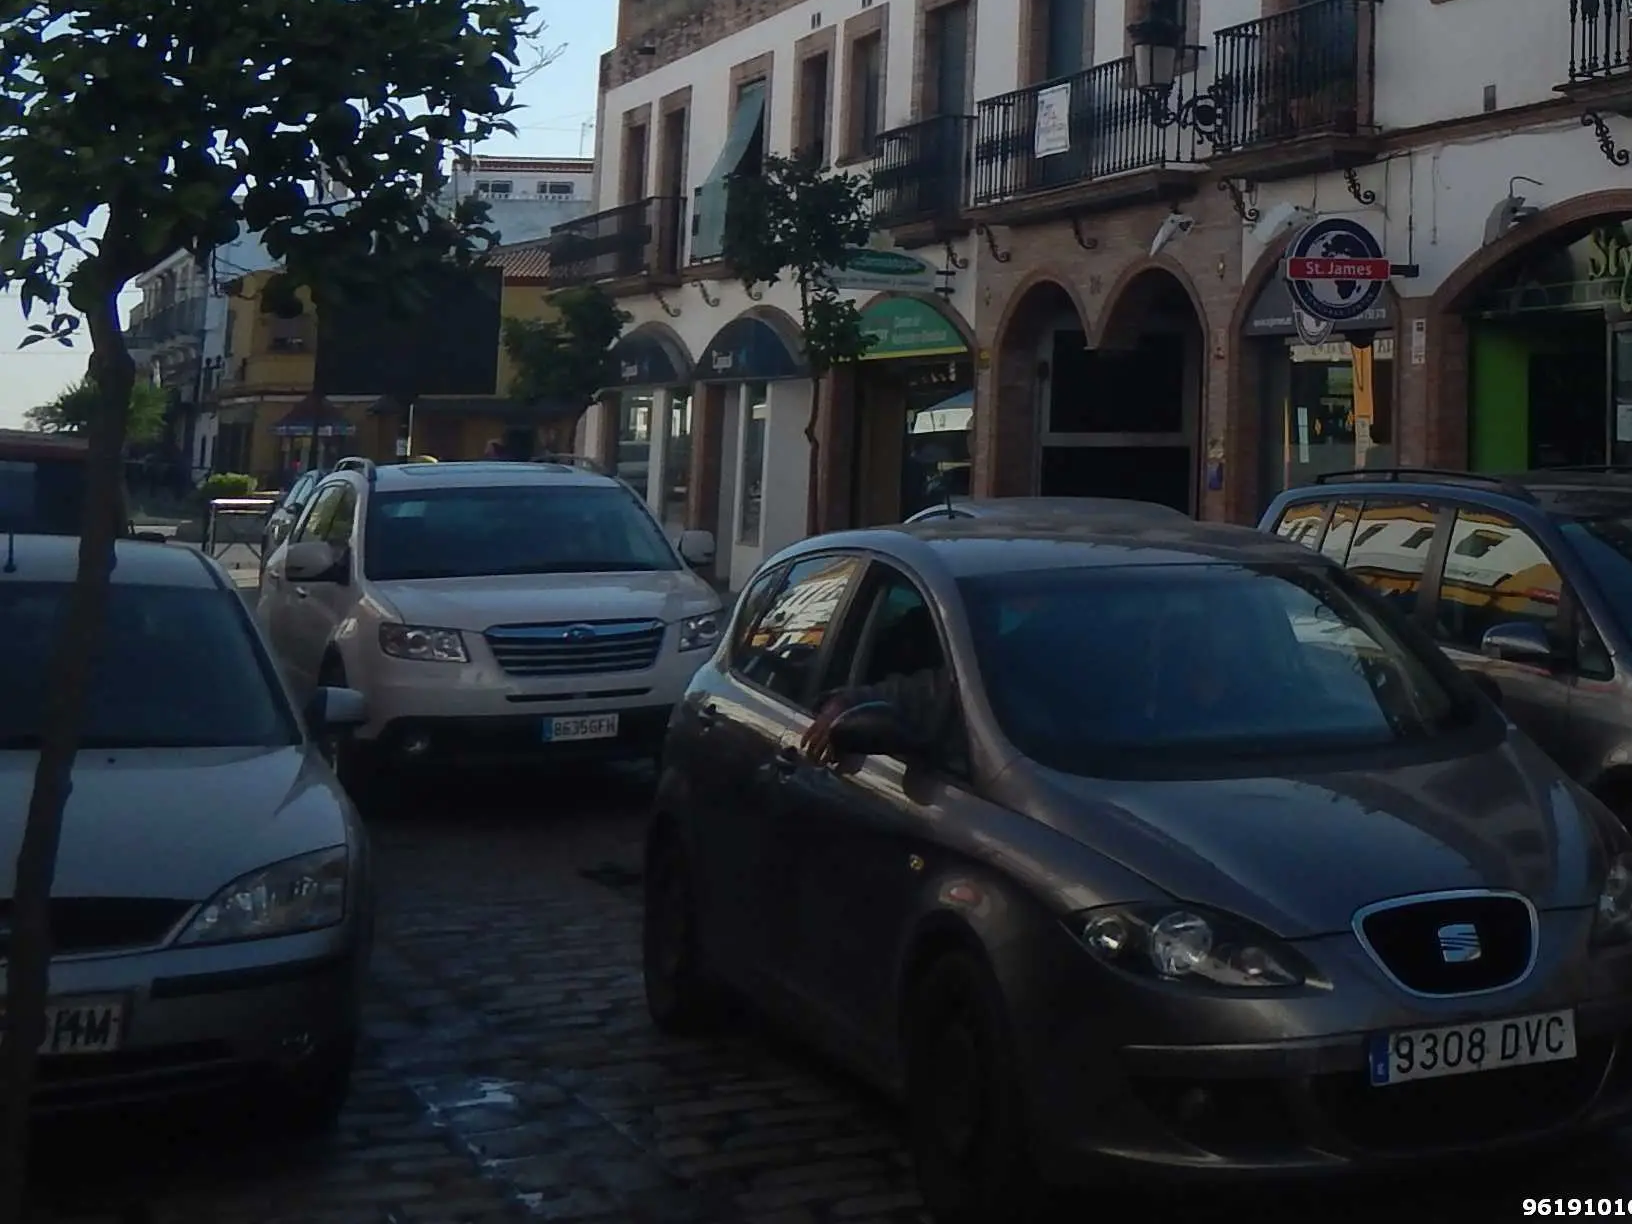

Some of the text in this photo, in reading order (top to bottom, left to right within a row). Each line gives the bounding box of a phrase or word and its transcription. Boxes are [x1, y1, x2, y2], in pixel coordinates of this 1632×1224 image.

[1305, 261, 1373, 276] St. James
[1395, 1016, 1564, 1074] 9308 DVC
